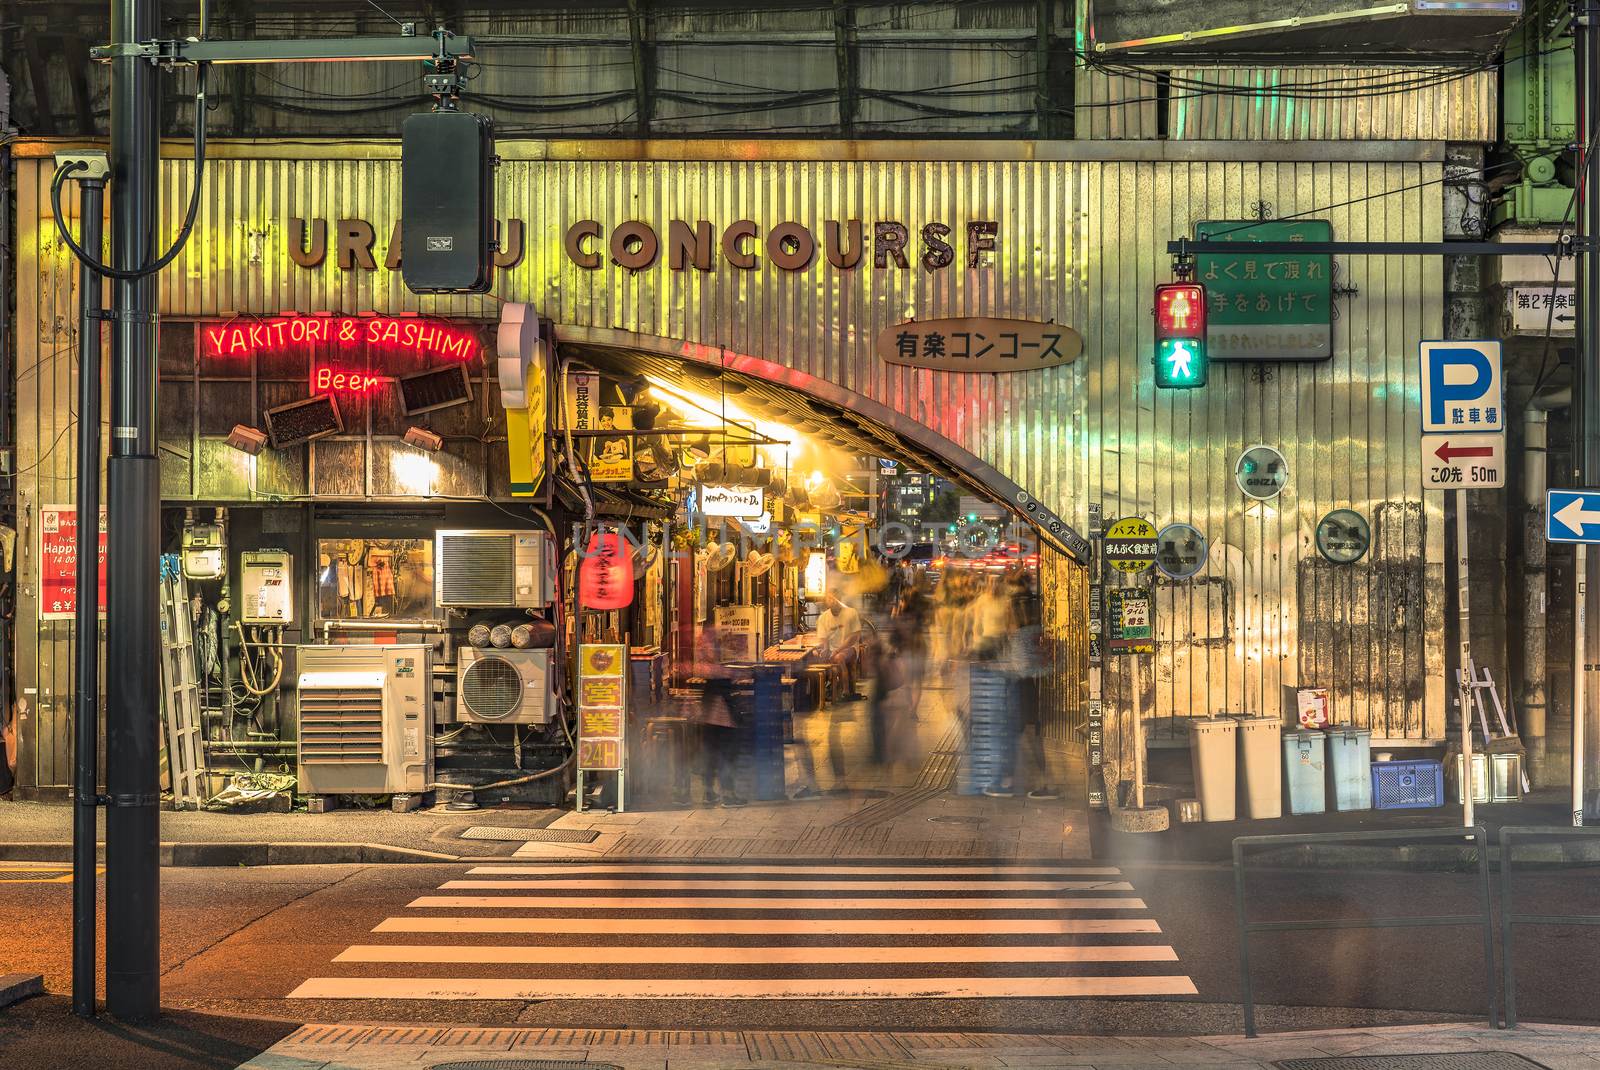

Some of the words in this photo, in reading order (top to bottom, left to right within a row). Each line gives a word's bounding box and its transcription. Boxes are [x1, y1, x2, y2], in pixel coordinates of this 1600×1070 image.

[288, 218, 526, 270] URU
[1204, 260, 1323, 280] よく見て渡れ
[1214, 292, 1317, 312] 手をあげて
[209, 319, 328, 354] YAKITORI
[339, 319, 357, 341] &
[367, 320, 472, 358] SASHIMI
[895, 329, 1063, 360] 有楽コンコース
[317, 368, 378, 392] Beer
[1429, 348, 1493, 425] P
[1452, 407, 1498, 424] 駐車場
[1431, 466, 1463, 483] この先
[1471, 466, 1498, 483] 50m
[1113, 524, 1149, 536] バス停
[1117, 560, 1147, 571] 営業中
[1123, 601, 1148, 609] サービス
[583, 682, 620, 734] 営業
[583, 742, 617, 768] 24H
